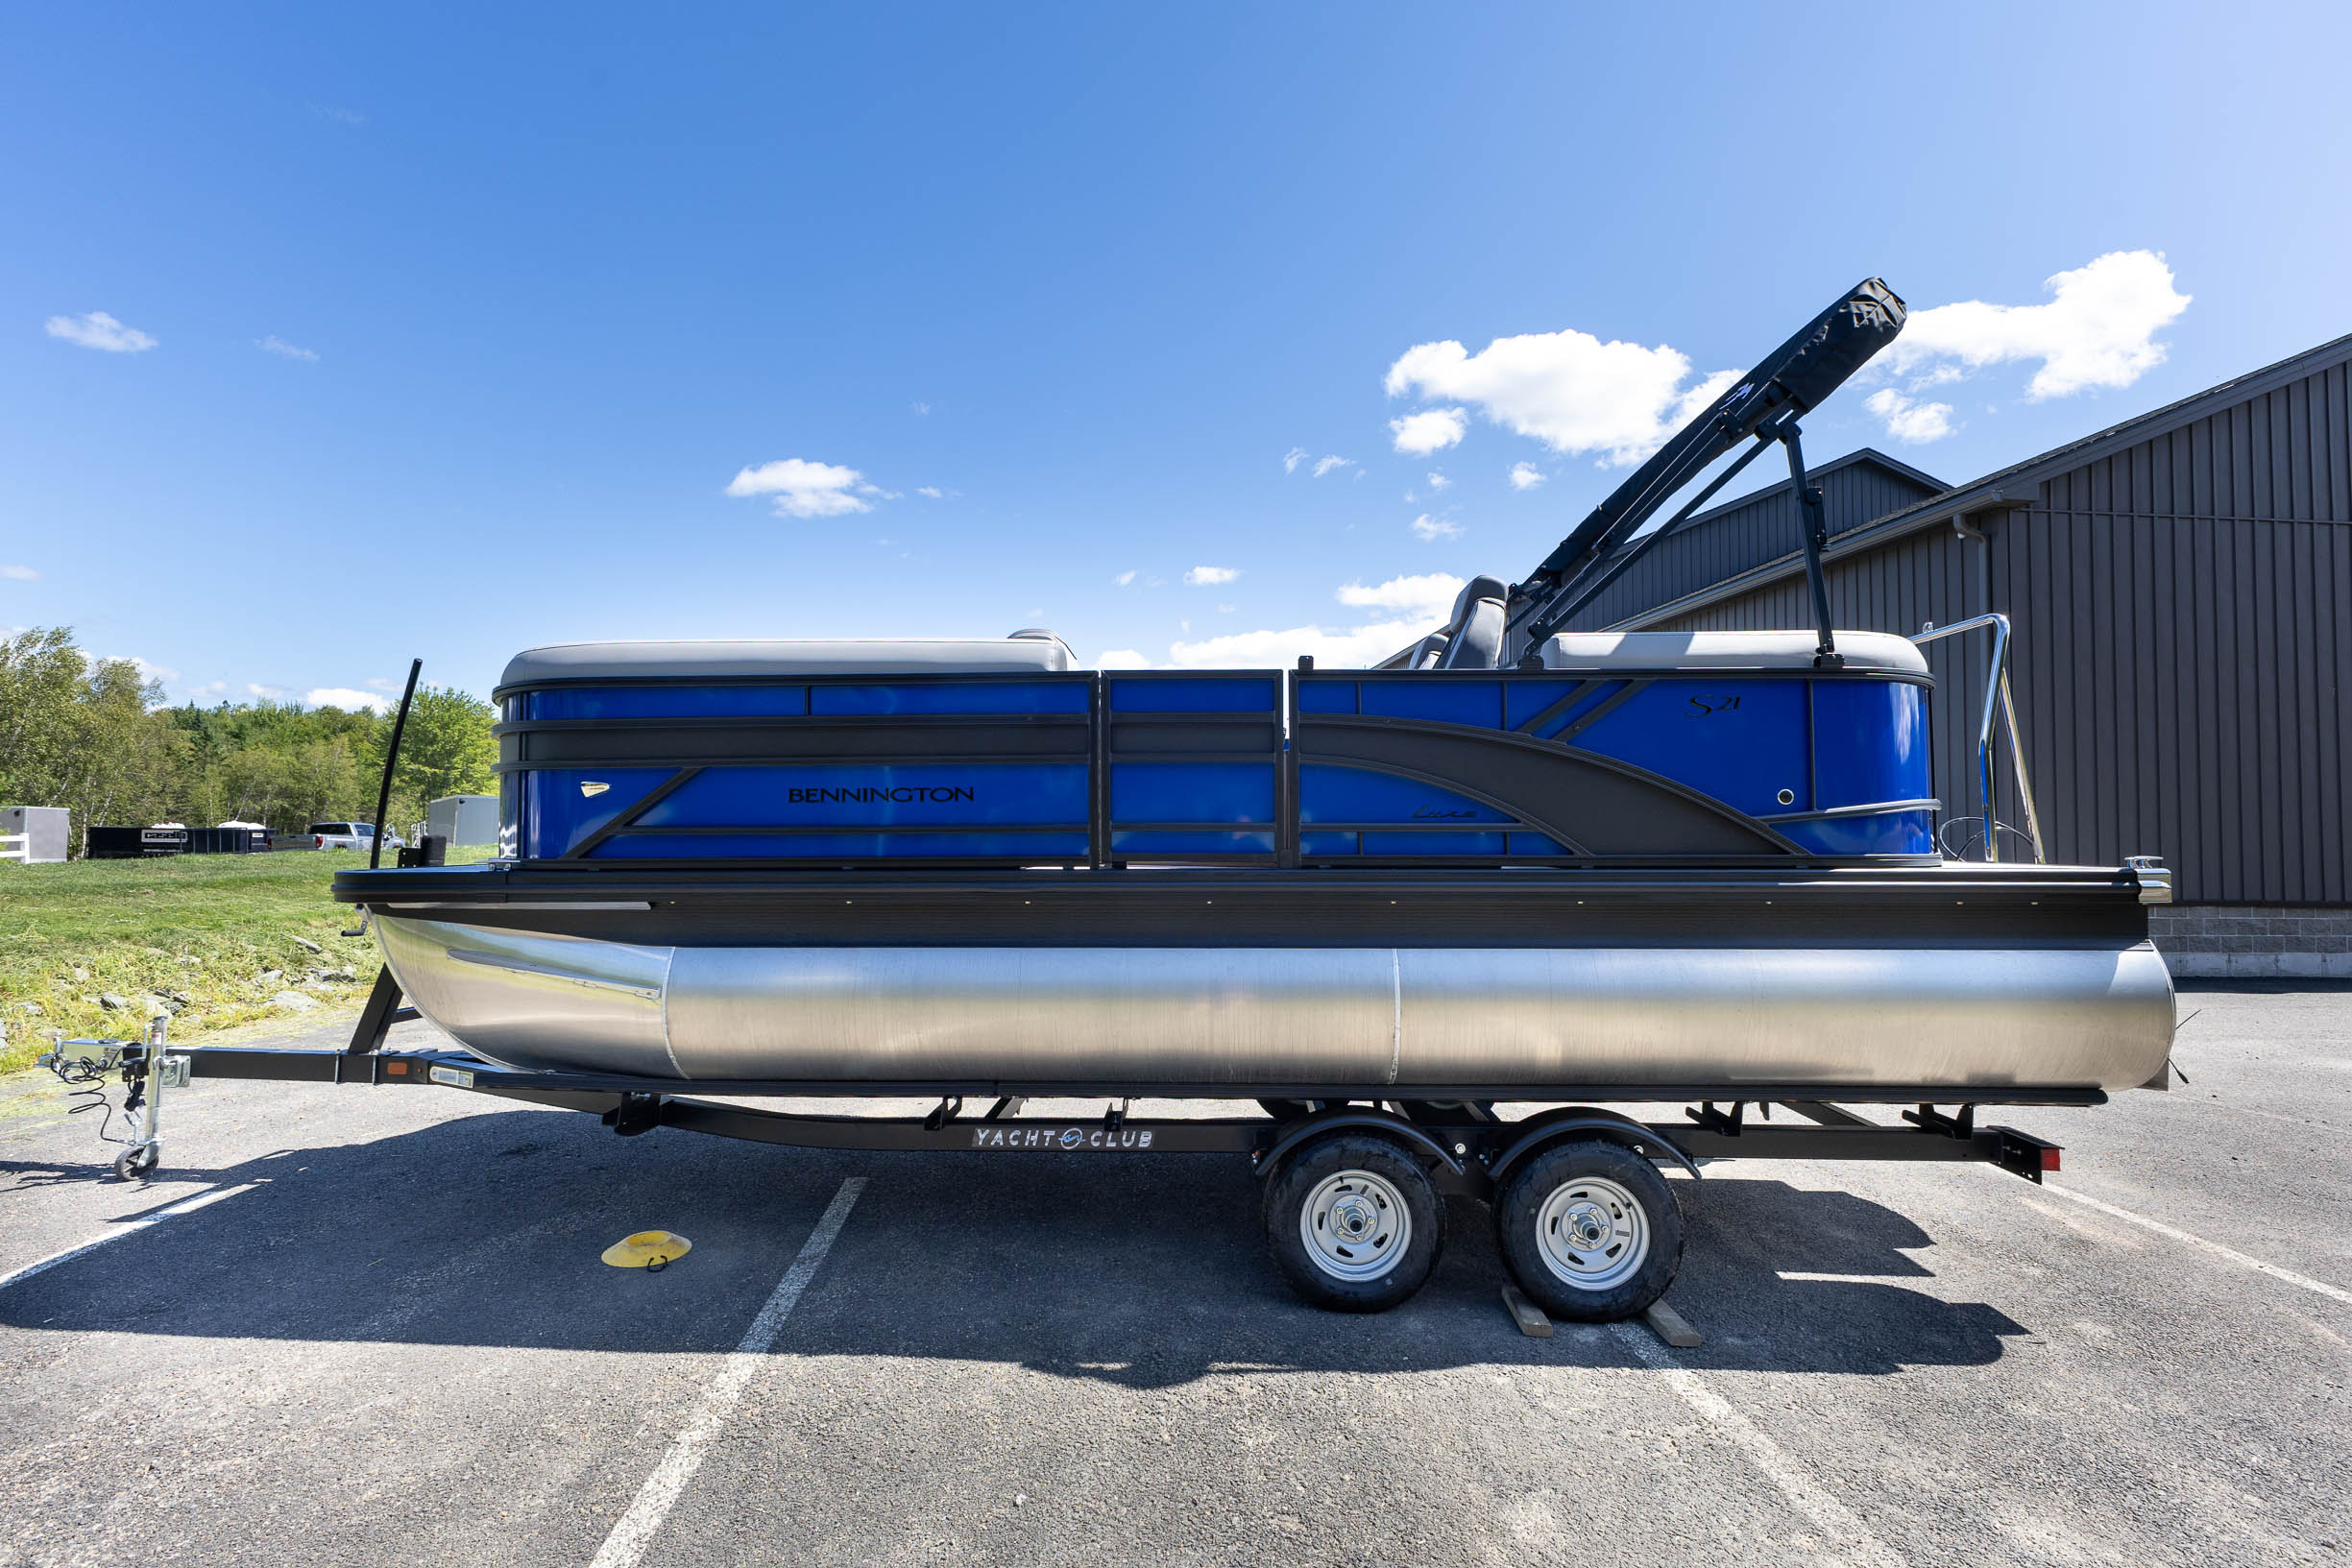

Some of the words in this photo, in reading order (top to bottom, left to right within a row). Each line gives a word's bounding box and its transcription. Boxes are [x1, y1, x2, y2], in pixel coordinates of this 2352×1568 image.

[788, 786, 975, 804] BENNINGTON
[976, 1128, 1055, 1147] YACHT
[1090, 1130, 1152, 1148] CLUB
